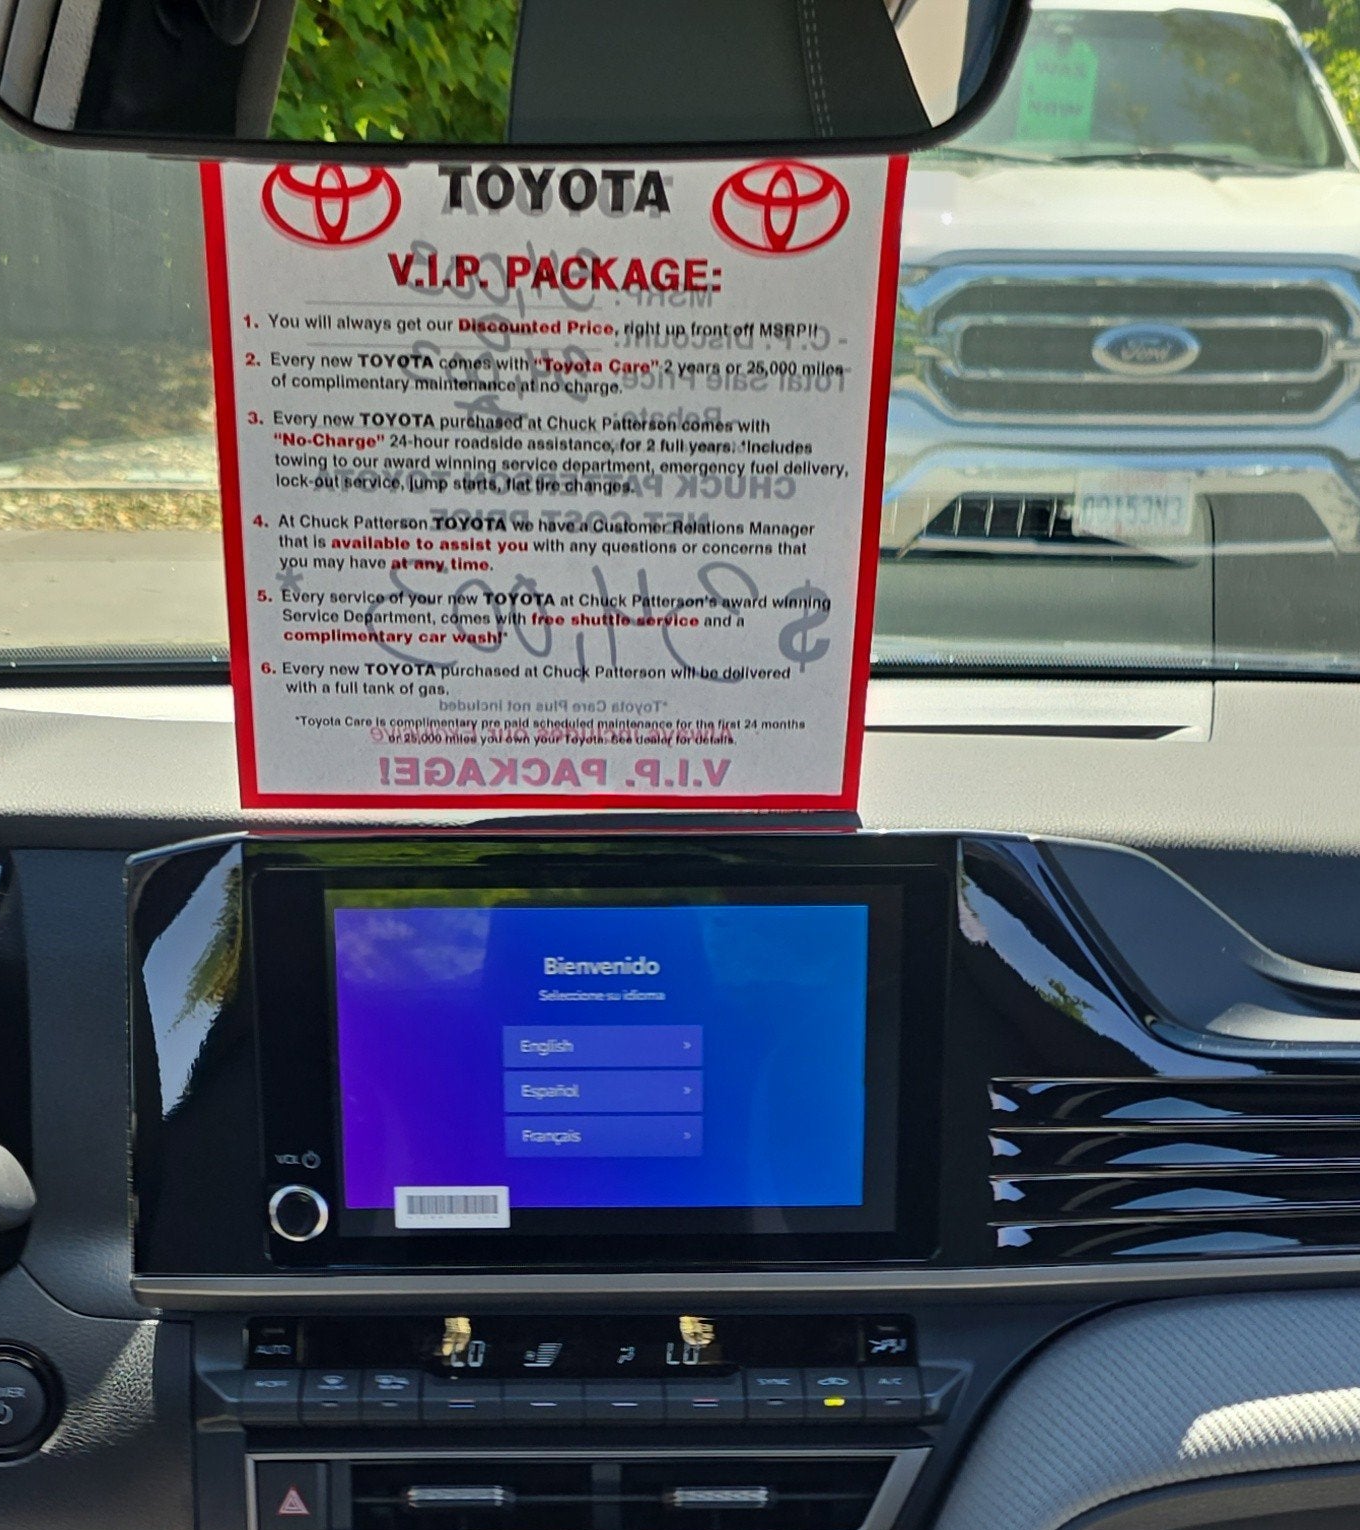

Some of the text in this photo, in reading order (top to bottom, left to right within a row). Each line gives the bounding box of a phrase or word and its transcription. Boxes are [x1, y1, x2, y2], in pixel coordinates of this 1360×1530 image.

[437, 165, 670, 213] TOYOTA
[388, 252, 723, 292] V.I.P. PACKAGE:
[243, 314, 260, 329] 1.
[267, 314, 300, 329] You
[304, 315, 332, 330] will
[336, 315, 392, 334] always
[396, 316, 421, 335] get
[426, 320, 453, 332] our
[458, 317, 561, 334] Discounted
[566, 319, 620, 336] Price,
[623, 320, 661, 339] right
[665, 324, 685, 339] up
[690, 321, 729, 337] front
[732, 322, 755, 337] off
[245, 352, 261, 367] 2.
[270, 352, 315, 371] Every
[320, 356, 353, 368] new
[357, 354, 434, 369] TOYOTA
[439, 358, 492, 370] comes
[495, 356, 529, 371] with
[663, 358, 673, 373] 2
[676, 361, 720, 377] years
[724, 362, 742, 374] or
[746, 359, 797, 377] 25,000
[801, 360, 844, 376] miles
[252, 514, 816, 538] 4. At Chuck Patterson TOYOTA we have a Customer Relations Manager
[278, 534, 808, 557] that is available to assist you with any questions or concerns that
[283, 629, 413, 647] complimentary
[418, 633, 446, 644] car
[260, 662, 791, 681] 6. Every new TOYOTA purchased at Chuck Patterson will be delivered
[285, 680, 450, 699] with a full tank of gas.
[344, 715, 373, 727] Care
[375, 715, 387, 728] is
[389, 716, 479, 731] complimentary
[480, 719, 501, 731] pre
[503, 716, 530, 731] paid
[532, 716, 594, 729] scheduled
[596, 717, 673, 729] maintenance
[675, 717, 693, 729] for
[695, 717, 715, 729] the
[717, 717, 741, 730] first
[743, 718, 758, 730] 24
[760, 718, 806, 730] months
[543, 955, 661, 976] Bienvenido
[538, 988, 666, 1002] Seleccione su idioma
[519, 1038, 575, 1056] English
[520, 1083, 580, 1100] Español
[521, 1128, 583, 1146] Français
